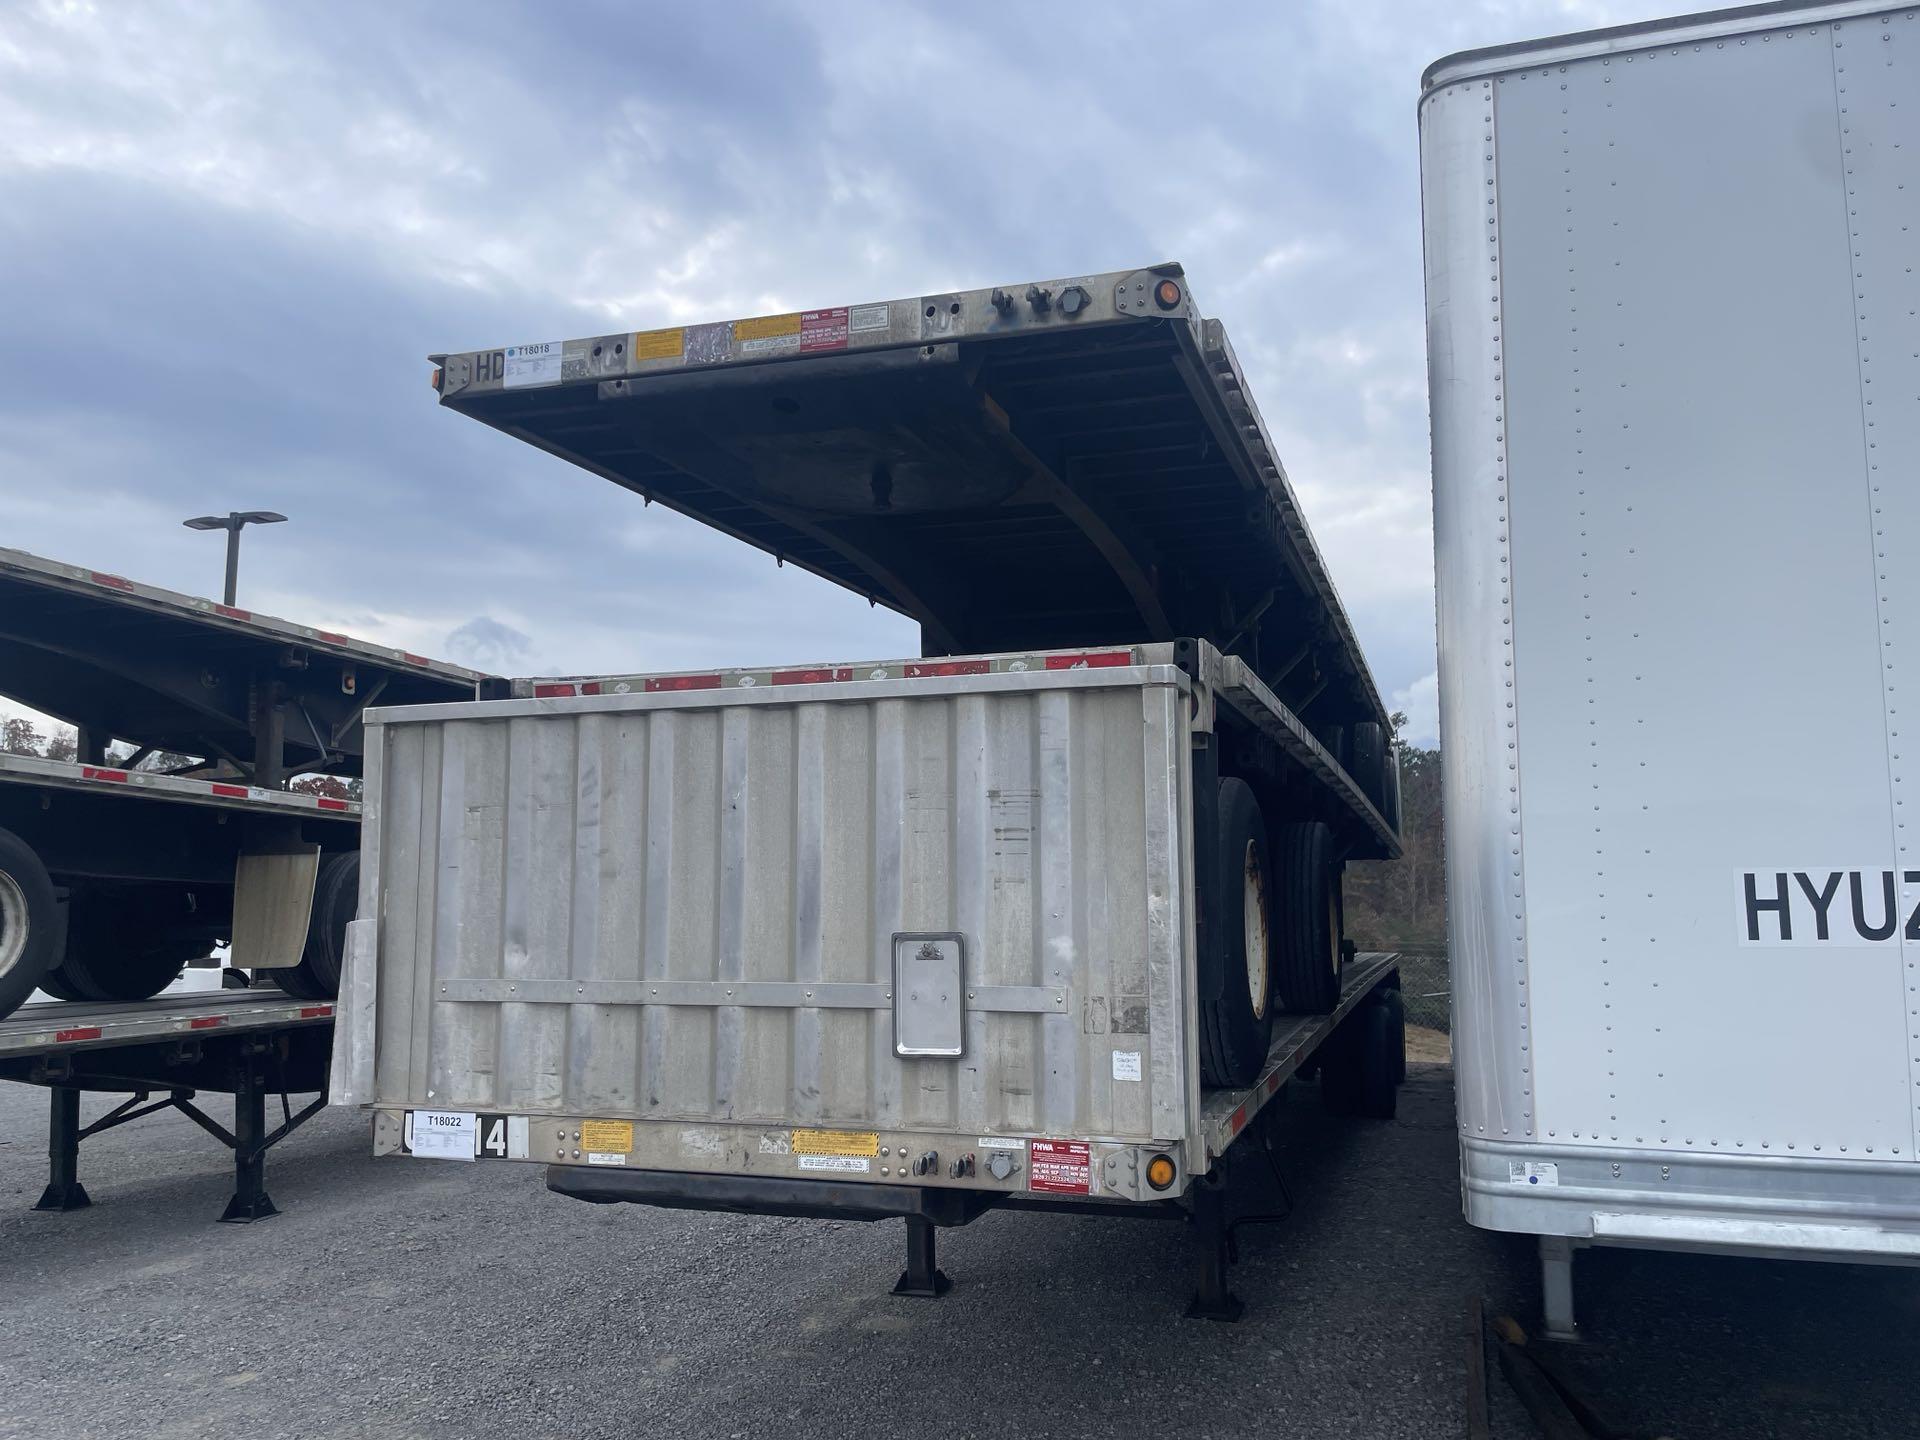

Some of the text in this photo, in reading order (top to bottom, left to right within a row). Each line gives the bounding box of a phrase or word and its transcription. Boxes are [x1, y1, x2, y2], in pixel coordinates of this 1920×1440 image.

[518, 344, 550, 356] T18018
[427, 1115, 462, 1127] T18022
[1032, 1142, 1054, 1151] FHWA
